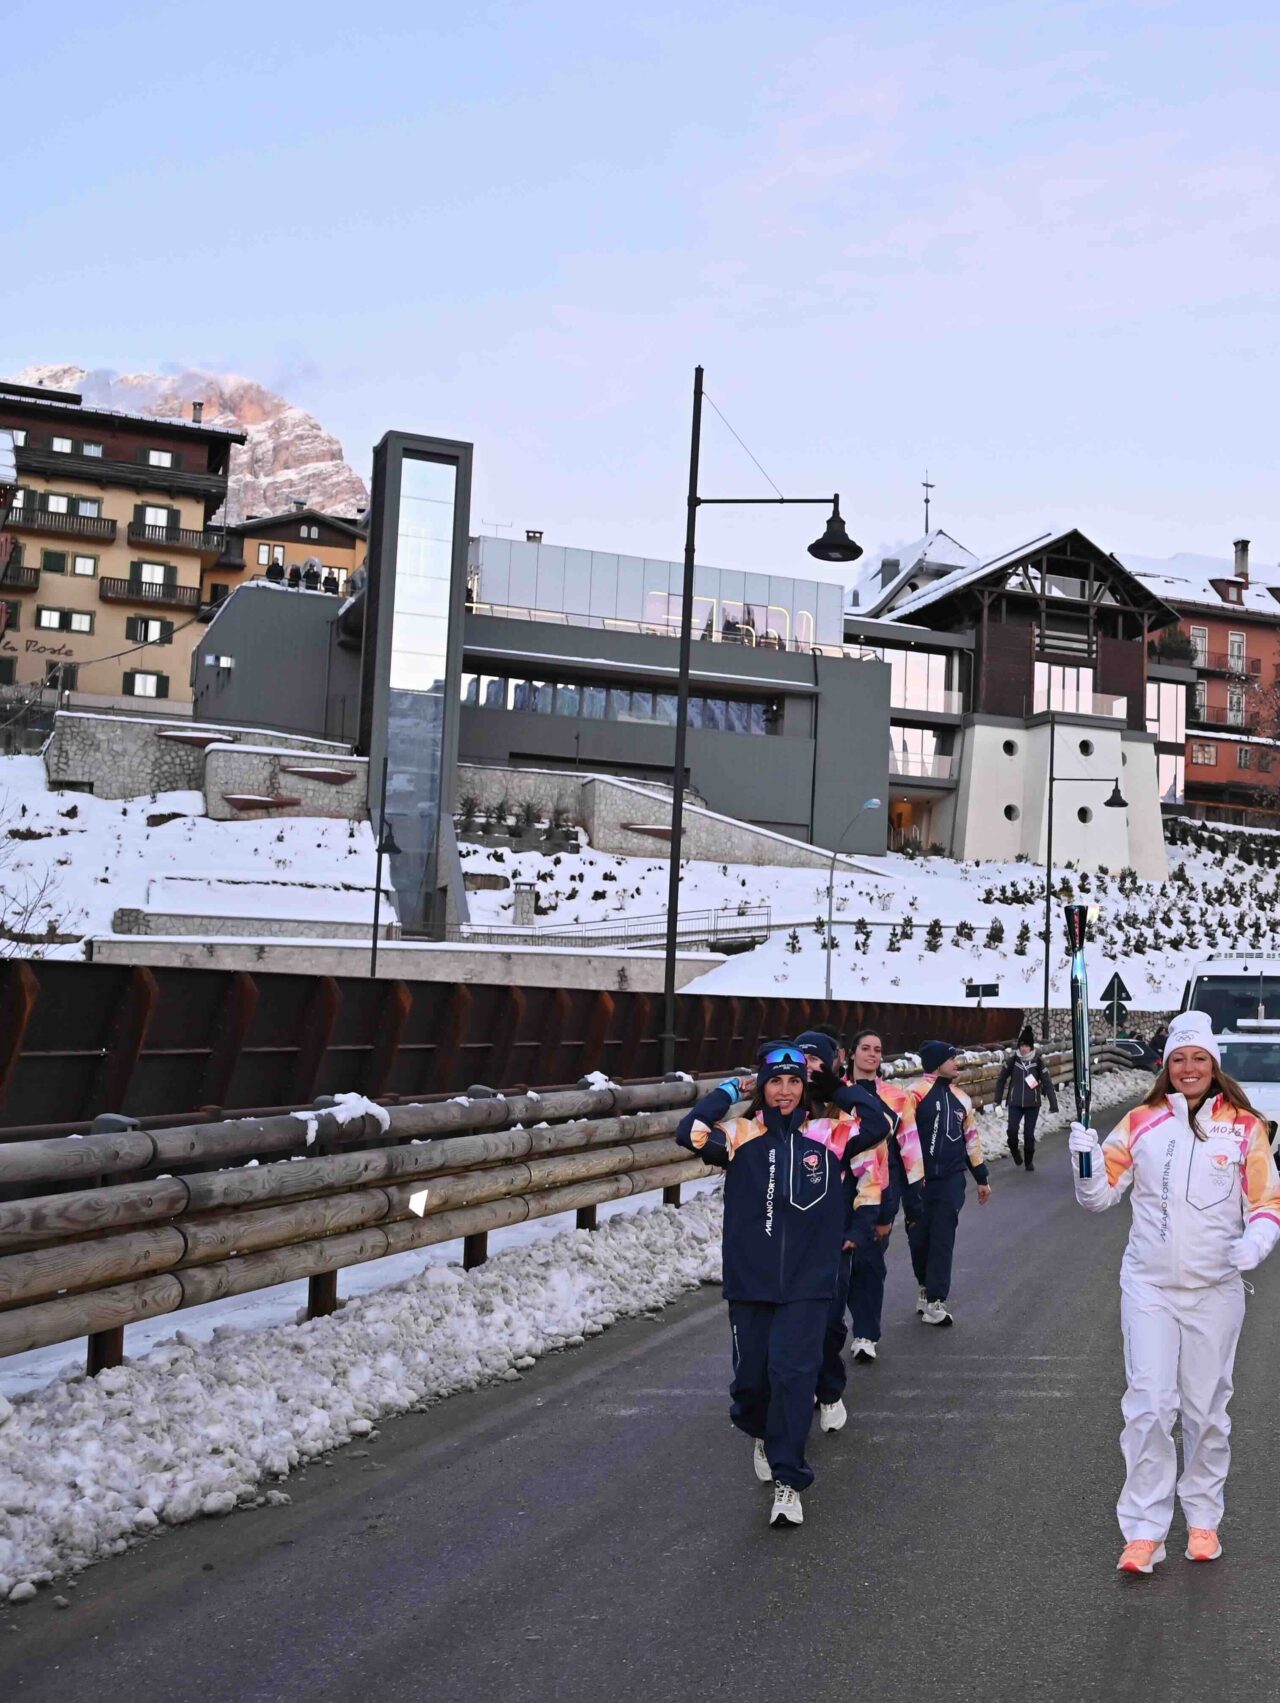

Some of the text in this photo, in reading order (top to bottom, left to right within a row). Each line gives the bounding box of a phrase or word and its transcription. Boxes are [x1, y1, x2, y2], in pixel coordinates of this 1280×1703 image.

[25, 640, 74, 656] Poste
[767, 1164, 776, 1200] CORTINA
[1160, 1139, 1176, 1243] MILANO CORTINA 2026
[765, 1200, 774, 1237] MILANO
